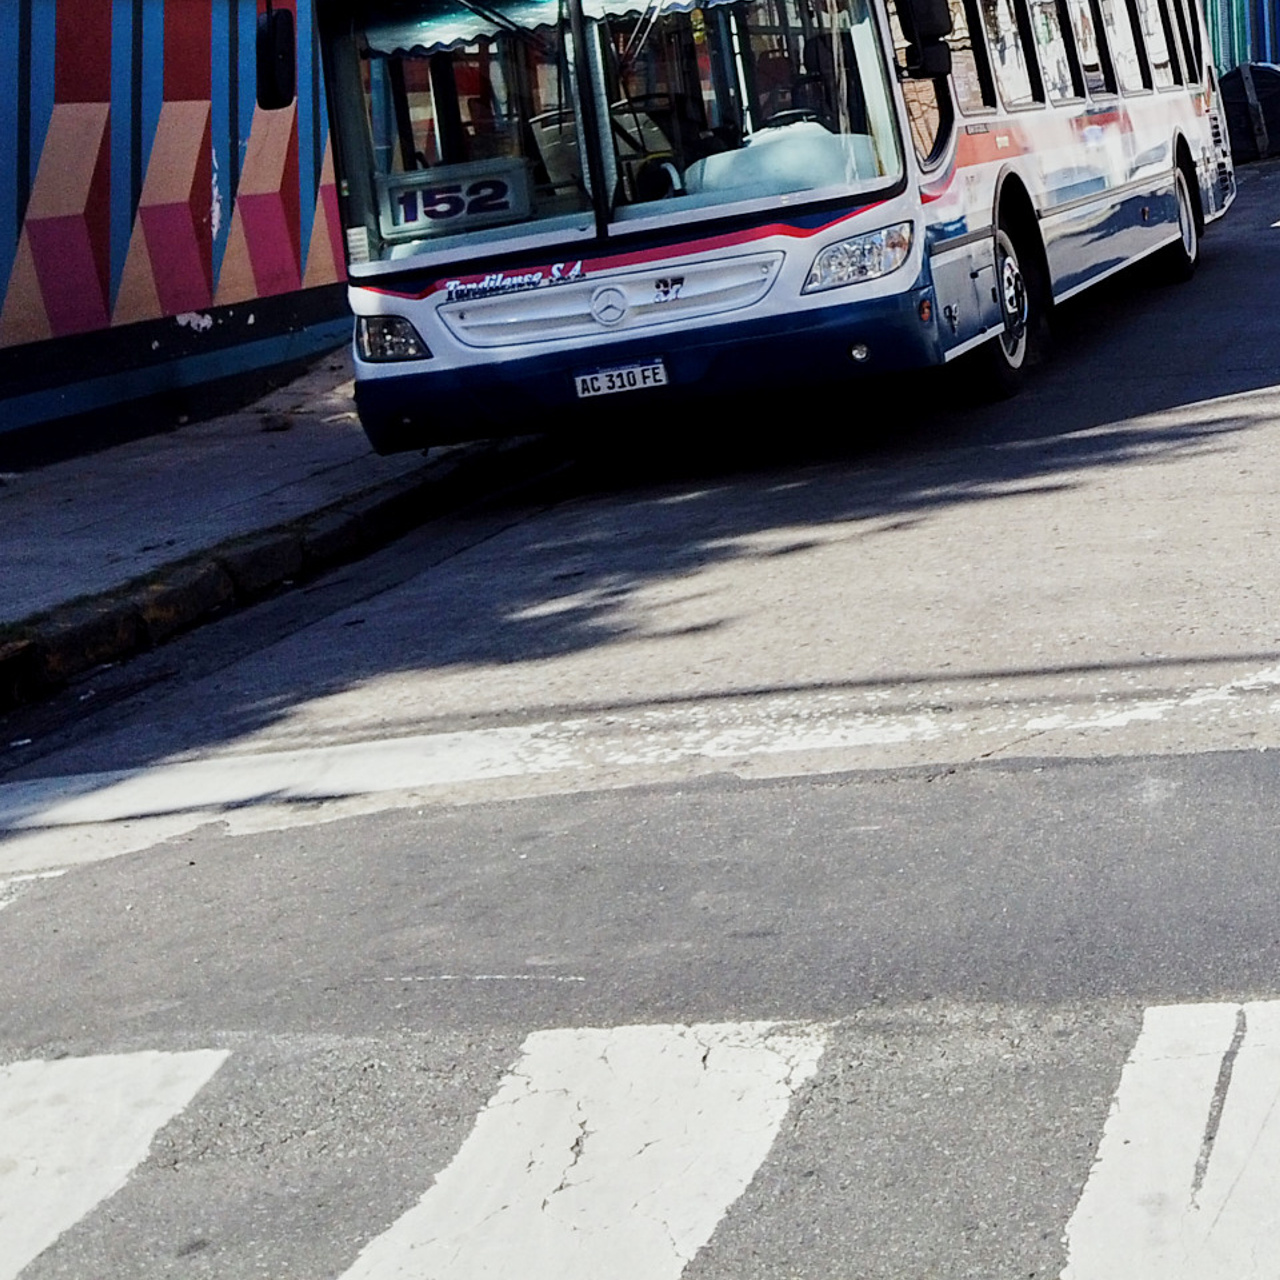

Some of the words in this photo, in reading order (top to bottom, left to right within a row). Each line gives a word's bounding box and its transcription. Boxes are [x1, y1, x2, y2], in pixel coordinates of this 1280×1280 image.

[397, 179, 510, 223] 152
[580, 376, 601, 395] AC
[605, 370, 637, 390] 310
[641, 366, 663, 385] FE
